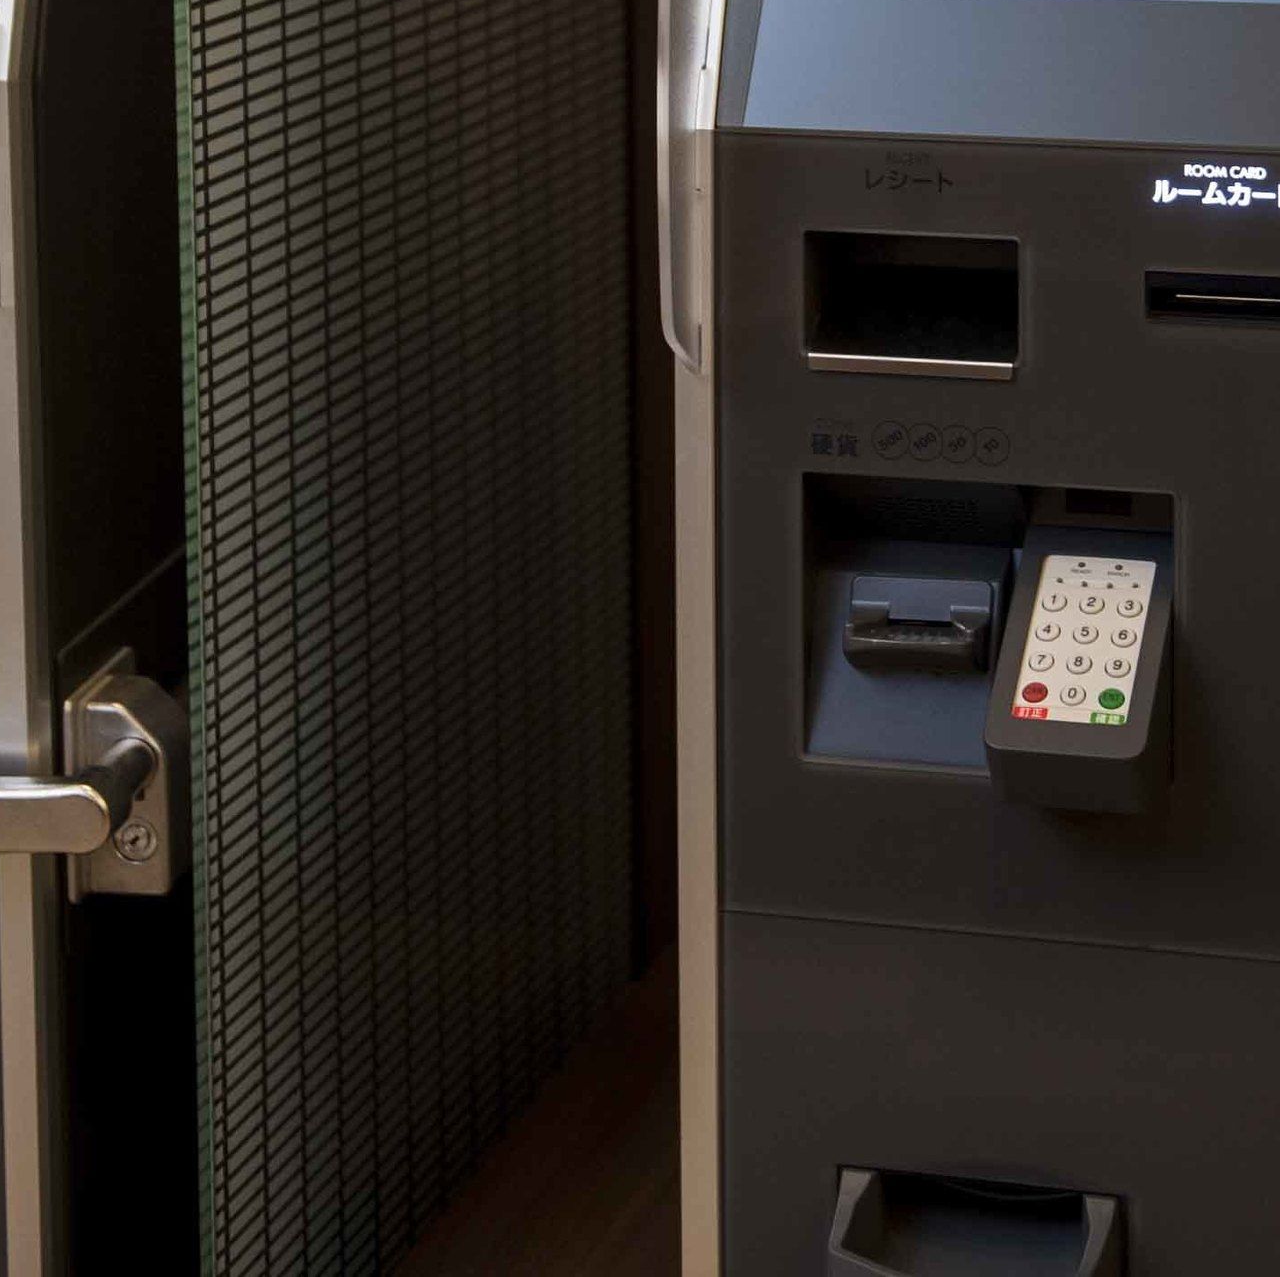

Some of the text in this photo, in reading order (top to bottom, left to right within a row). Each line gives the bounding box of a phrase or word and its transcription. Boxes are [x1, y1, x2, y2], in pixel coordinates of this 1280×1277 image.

[865, 169, 954, 193] レシート
[1183, 163, 1267, 180] ROOM CARD
